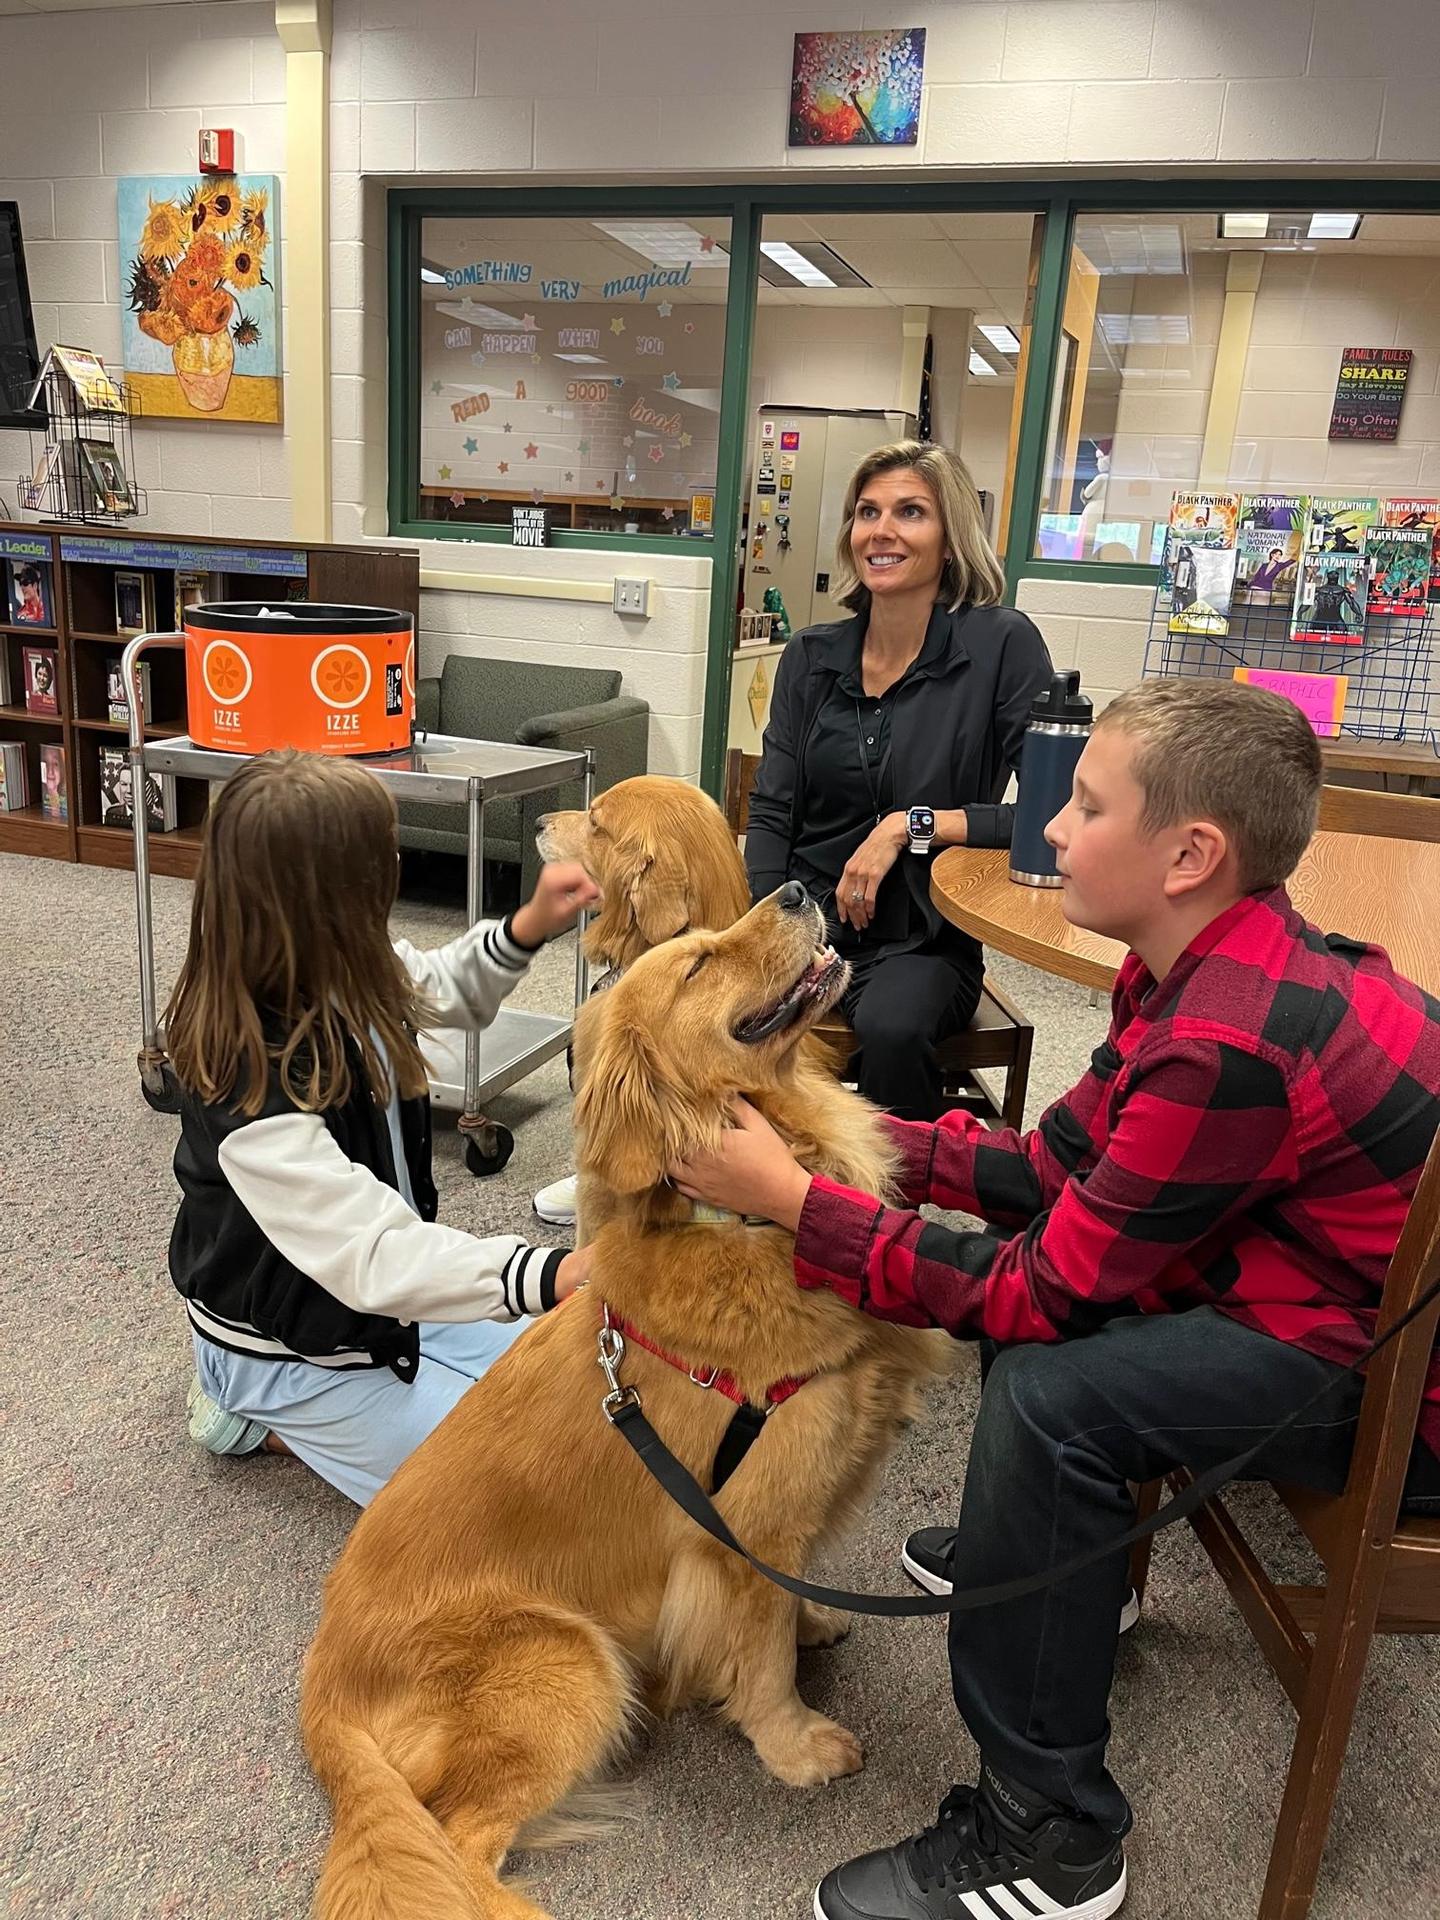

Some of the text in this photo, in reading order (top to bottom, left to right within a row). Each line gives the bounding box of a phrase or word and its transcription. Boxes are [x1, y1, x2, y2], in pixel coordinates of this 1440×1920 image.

[540, 280, 580, 300] VERY
[603, 260, 692, 301] magical
[445, 327, 471, 349] CAN
[481, 333, 536, 353] HAPPEN
[558, 328, 600, 348] WHEN
[1343, 349, 1411, 361] FAMILY RULES
[1340, 367, 1407, 380] SHARE
[1352, 393, 1377, 401] YOUR
[1378, 393, 1402, 402] BEST
[451, 392, 490, 423] READ
[515, 380, 526, 400] A
[630, 397, 680, 433] book
[1332, 414, 1398, 426] Hug Often
[1177, 494, 1233, 506] BLACK PANTHER
[1244, 497, 1300, 508] BLACK PANTHER
[1313, 500, 1372, 511] BLACK PANTHER
[1386, 502, 1410, 512] BLACK
[513, 526, 545, 546] MOVIE
[1247, 531, 1287, 540] NATIONAL
[1366, 529, 1428, 542] BLACK PANTHER
[1246, 538, 1285, 547] WOMAN'S
[1245, 545, 1271, 553] PARTY
[1304, 555, 1366, 569] BLACK PANTHER
[213, 709, 241, 728] IZZE
[327, 714, 361, 730] IZZE
[985, 1765, 1028, 1819] adidas
